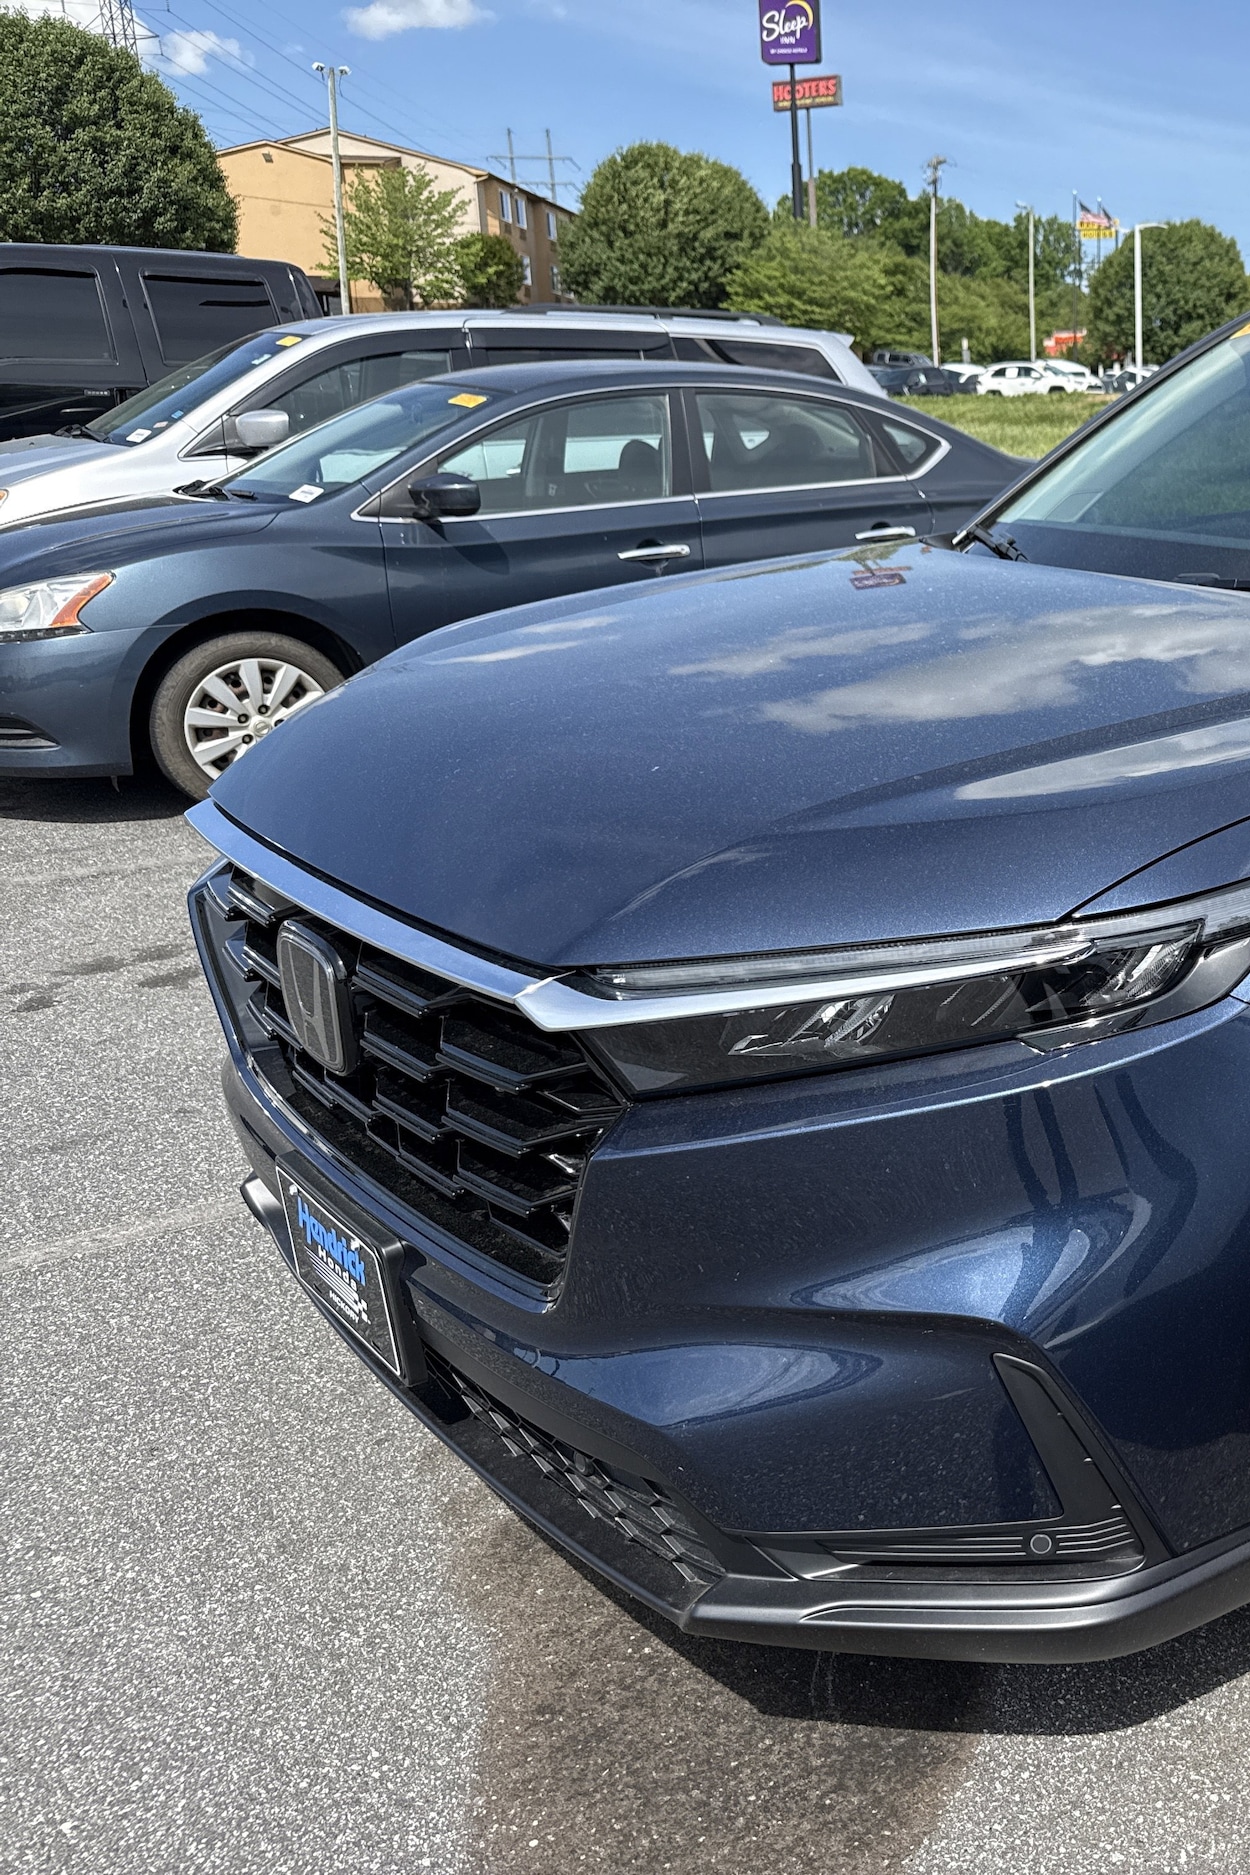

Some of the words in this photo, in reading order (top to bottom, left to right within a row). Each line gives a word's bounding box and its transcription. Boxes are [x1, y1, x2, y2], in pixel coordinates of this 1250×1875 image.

[762, 9, 808, 42] Sleep
[780, 36, 796, 44] INN
[773, 79, 837, 102] HOOTERS
[297, 1195, 366, 1287] Hendrick
[318, 1245, 357, 1291] Honda
[329, 1289, 360, 1323] HICKORY
